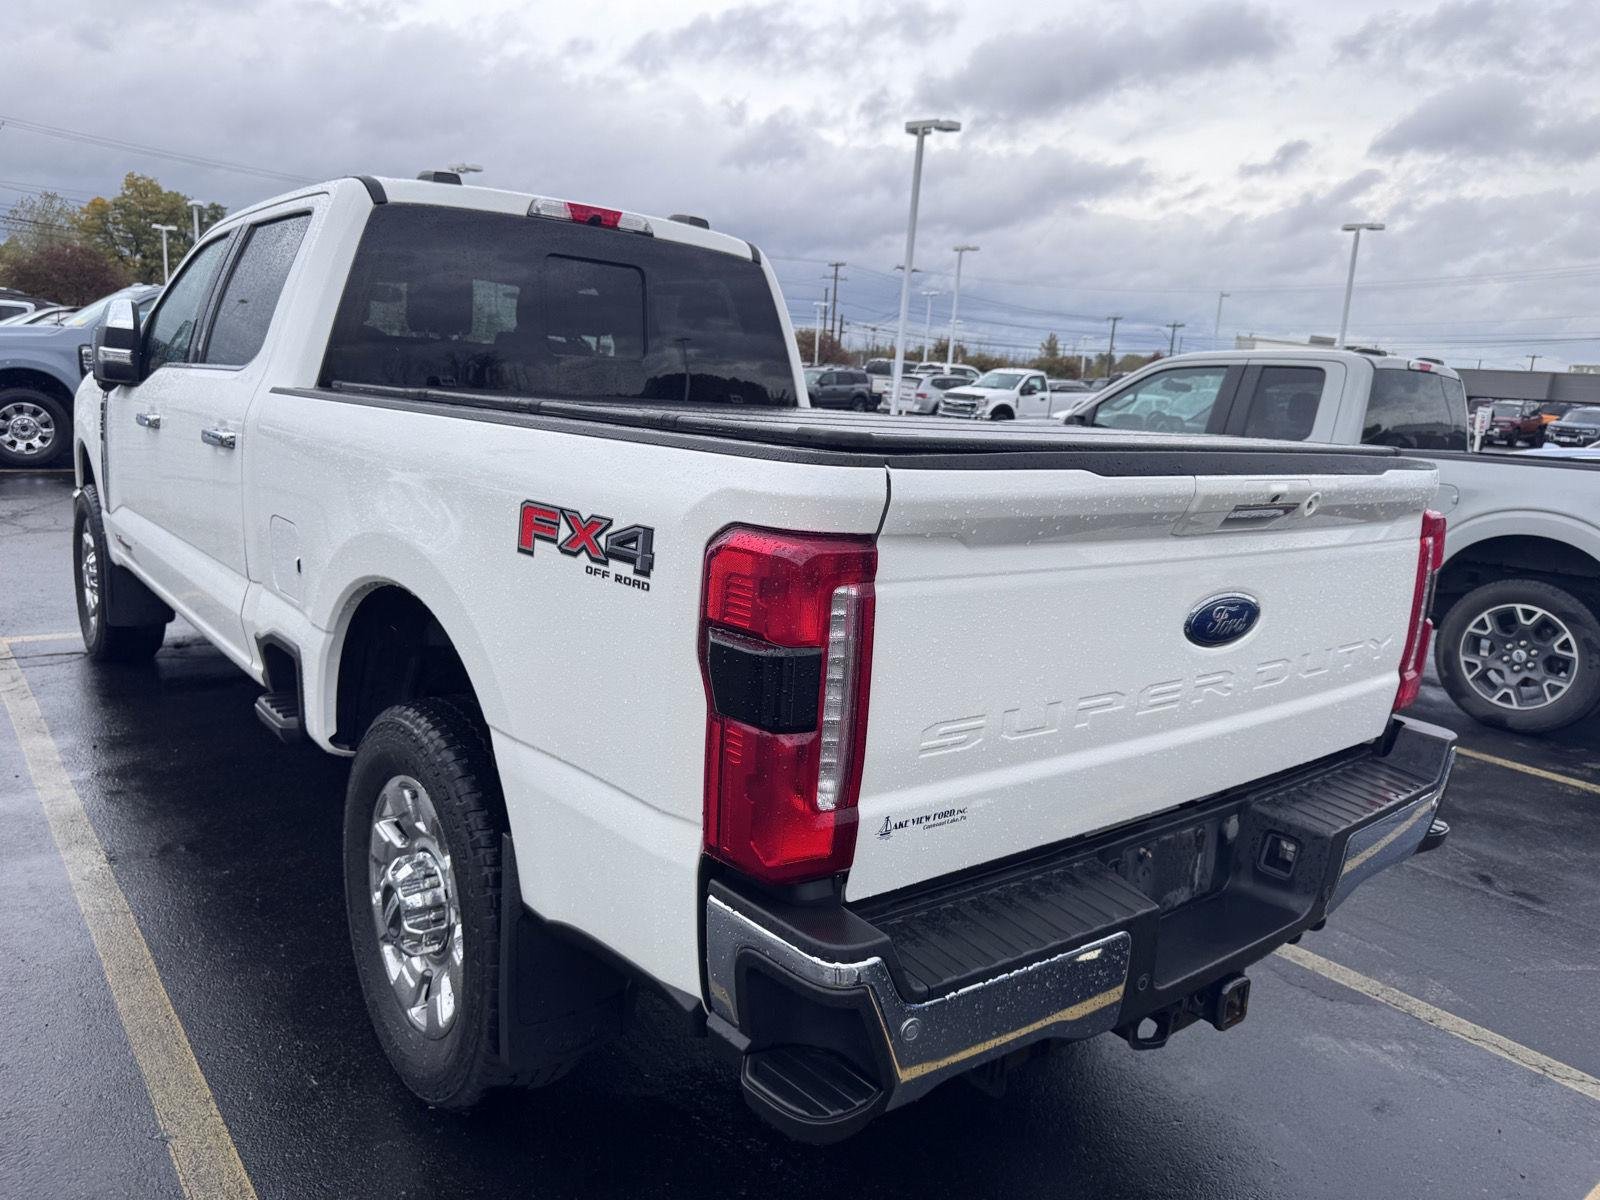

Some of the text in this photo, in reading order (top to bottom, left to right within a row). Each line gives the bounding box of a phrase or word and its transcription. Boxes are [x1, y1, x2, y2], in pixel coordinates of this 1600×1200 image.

[517, 499, 655, 578] FX4
[585, 564, 650, 592] OFF ROAD
[1207, 604, 1249, 635] Ford
[918, 634, 1392, 758] SUPER DUTY
[912, 815, 933, 826] VIEW
